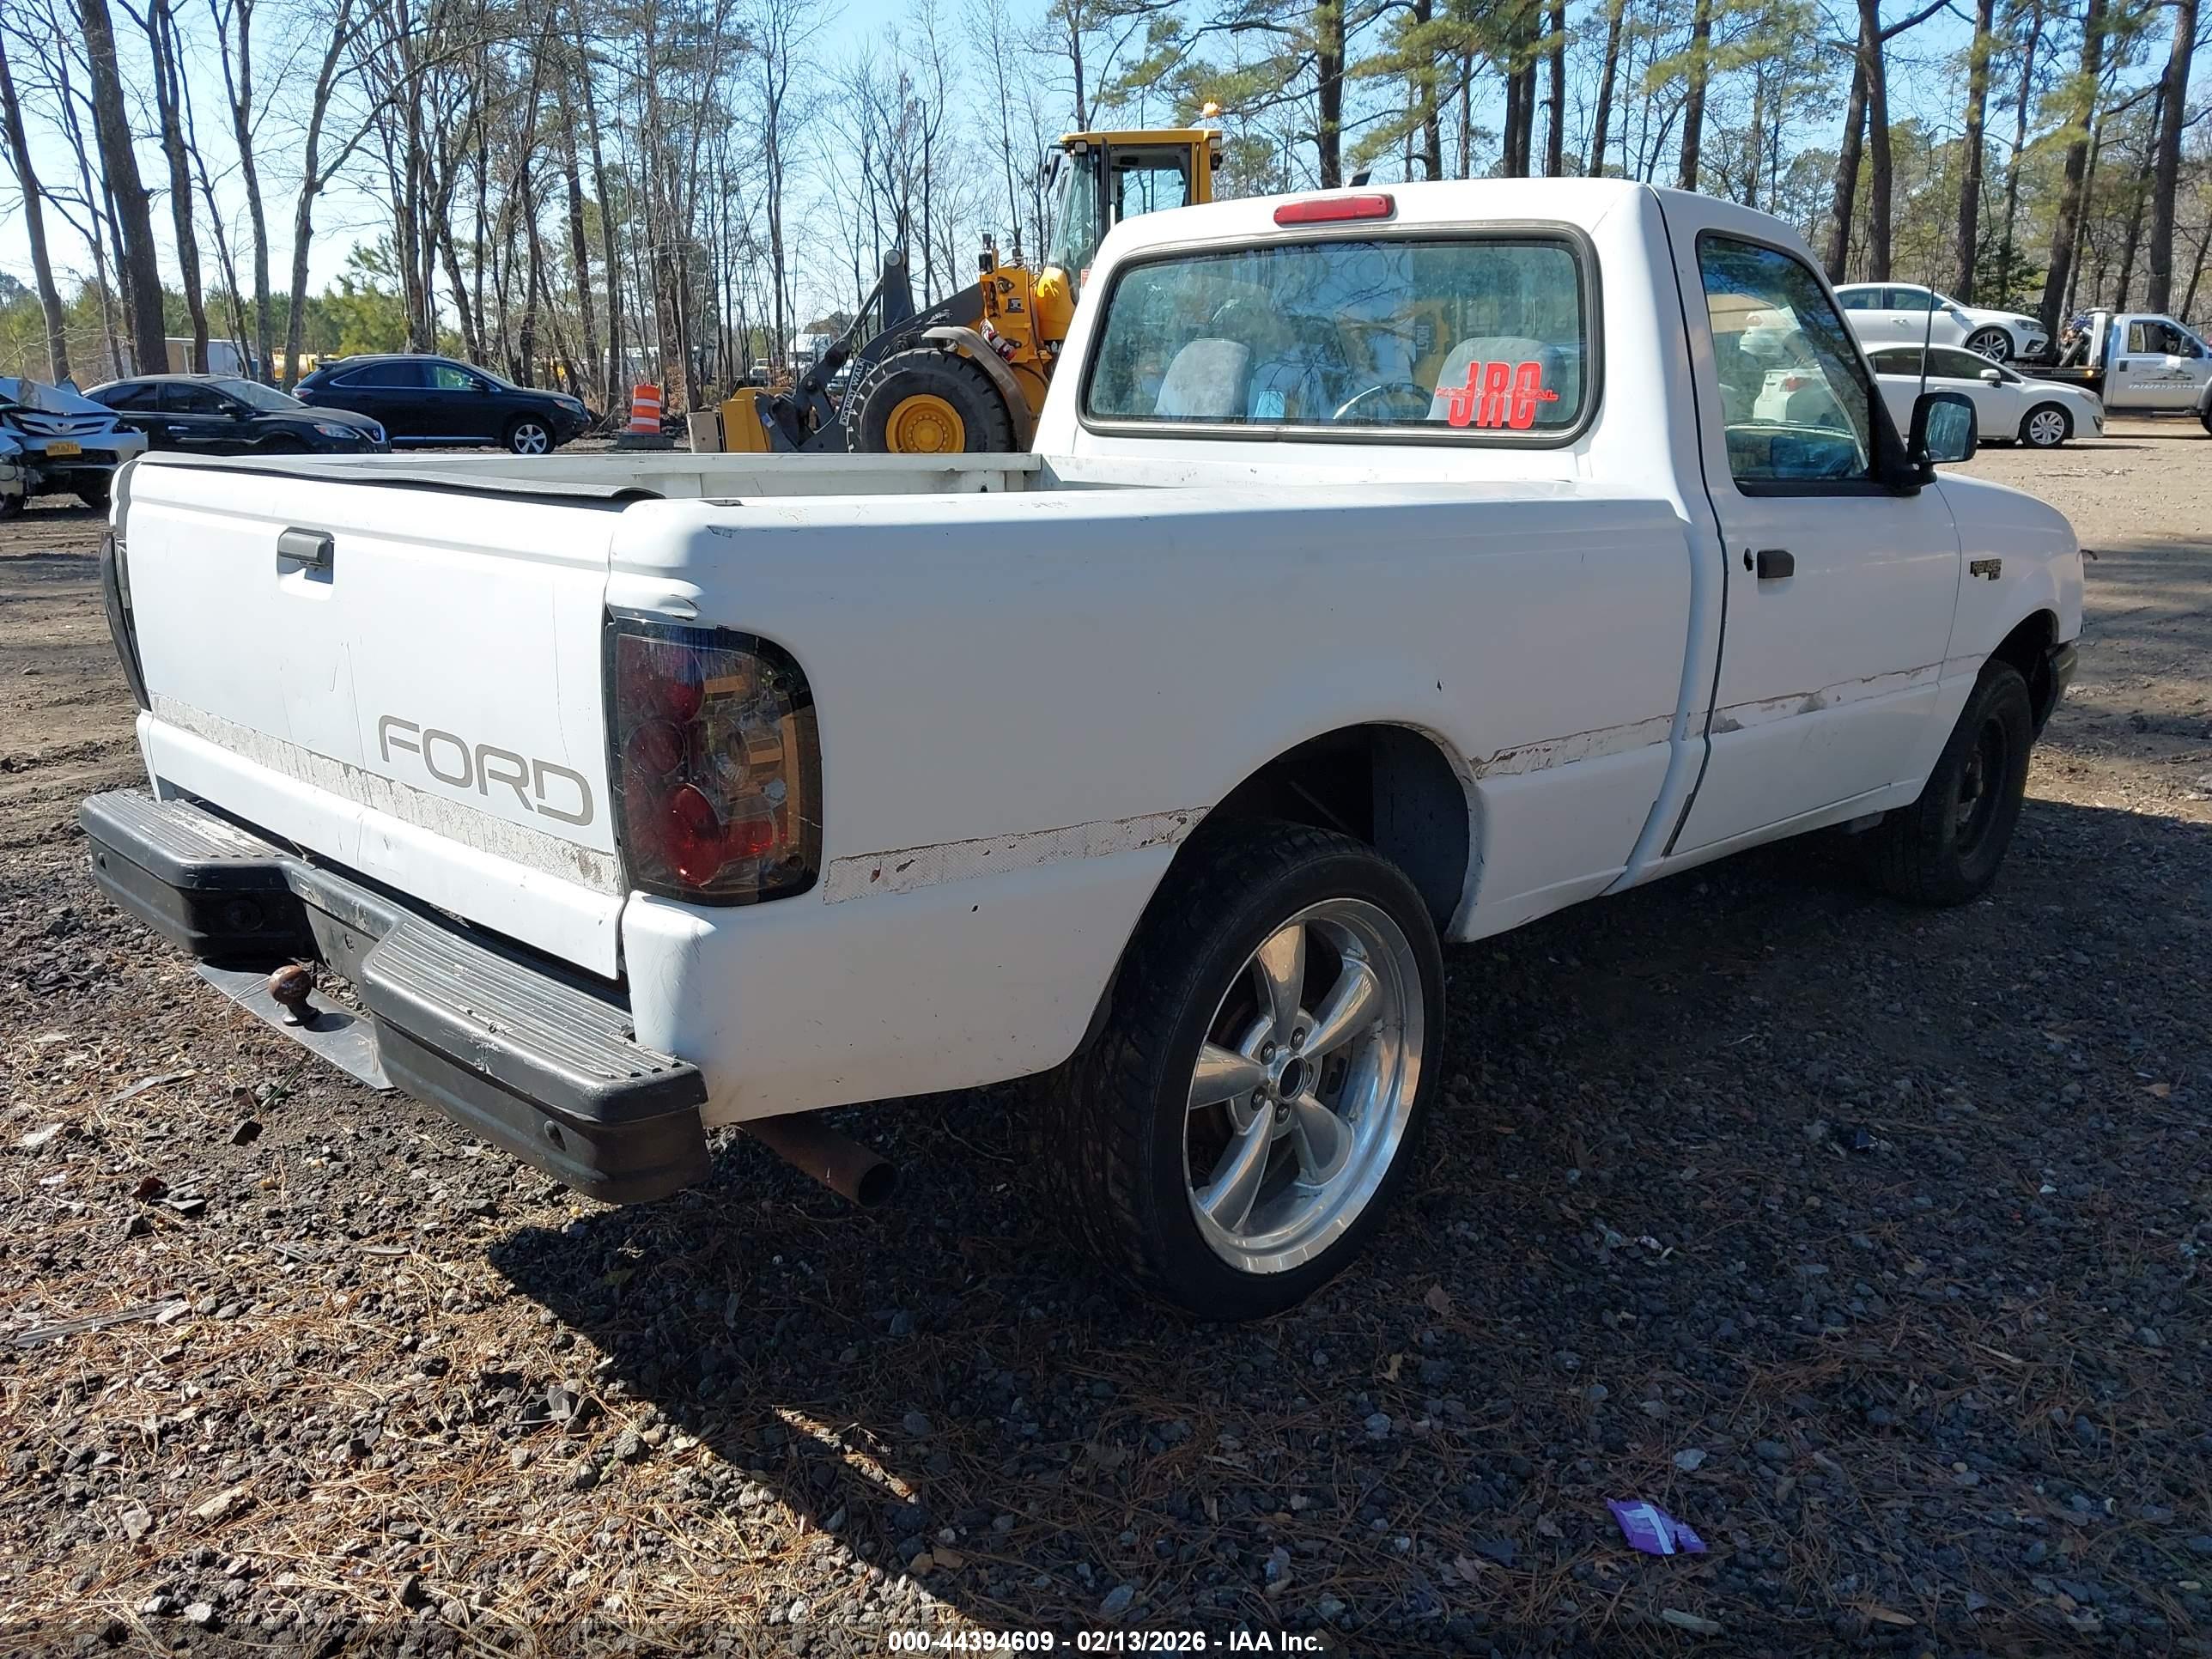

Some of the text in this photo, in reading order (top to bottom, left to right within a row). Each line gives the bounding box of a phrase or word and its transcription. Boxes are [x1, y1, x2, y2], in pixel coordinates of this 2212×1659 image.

[847, 389, 856, 408] NOT
[852, 360, 866, 386] WALK
[378, 714, 594, 827] FORD
